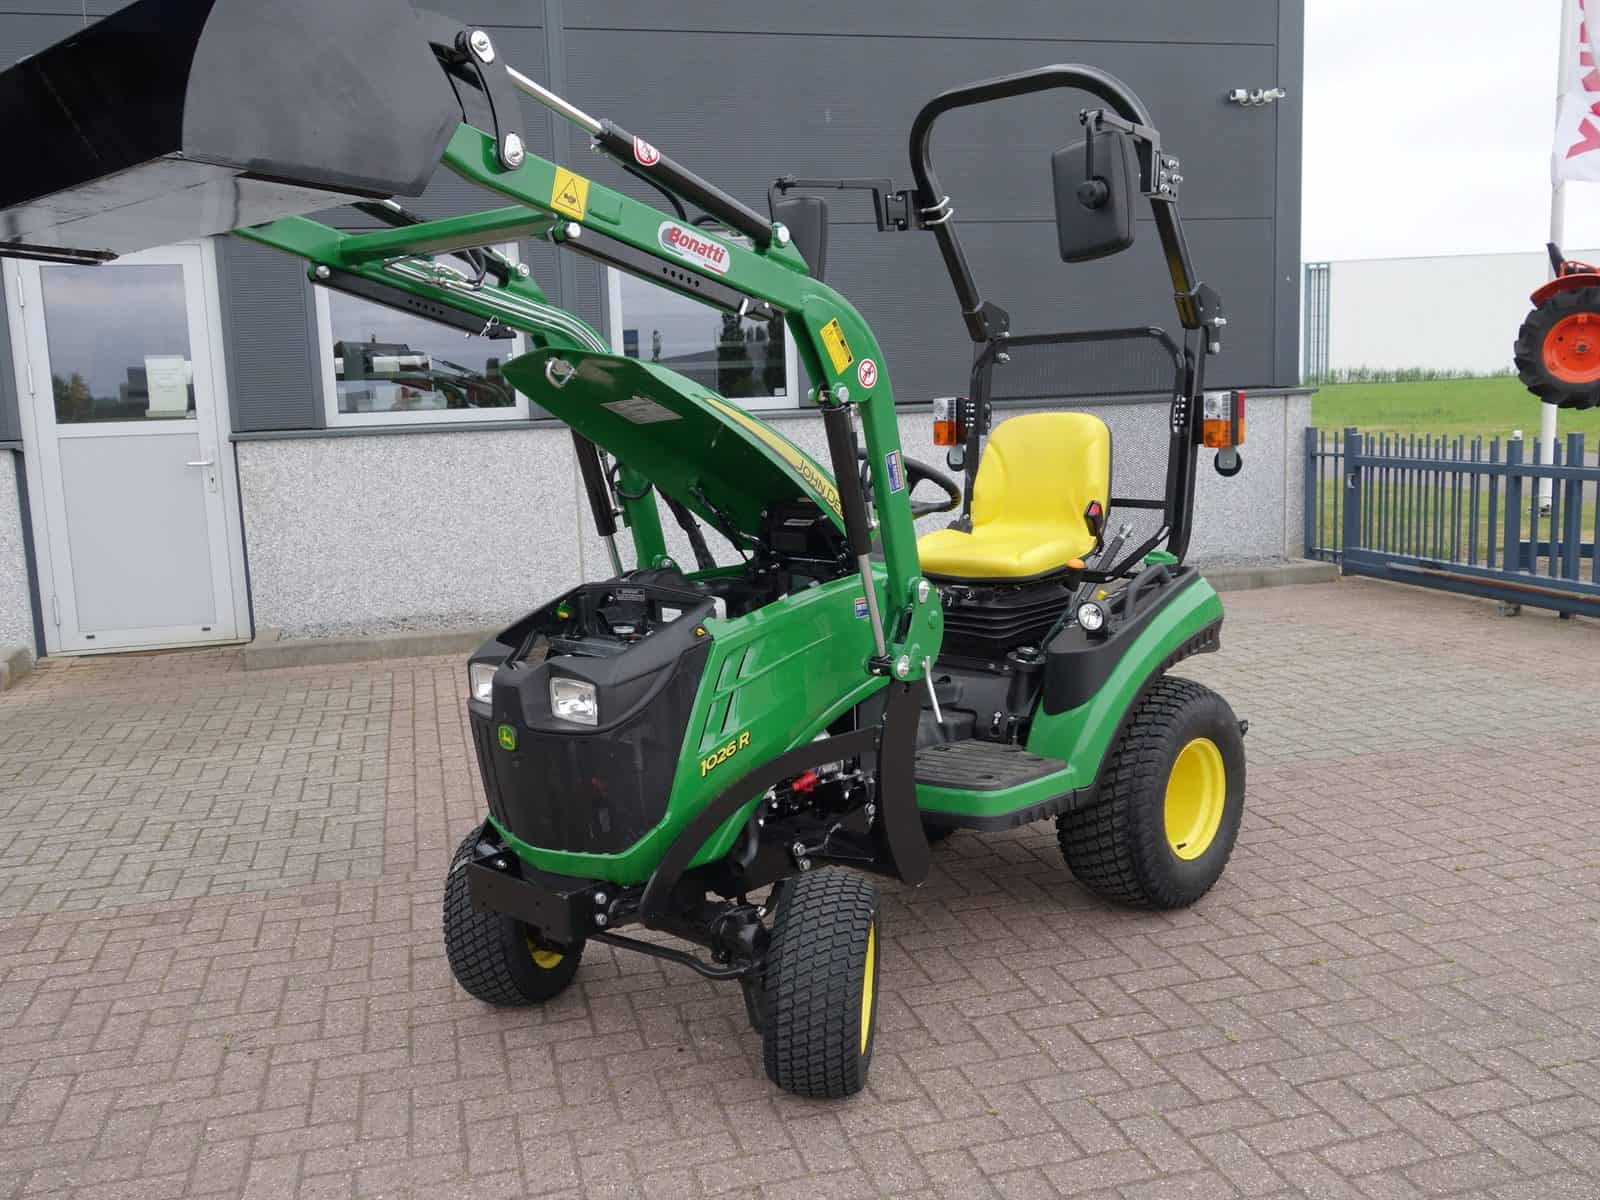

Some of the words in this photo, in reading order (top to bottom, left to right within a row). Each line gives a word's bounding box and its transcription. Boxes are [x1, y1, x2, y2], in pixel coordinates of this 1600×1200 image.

[668, 227, 726, 263] Bonatti
[795, 459, 826, 494] JOHN
[700, 740, 737, 777] 1026
[739, 731, 750, 750] R
